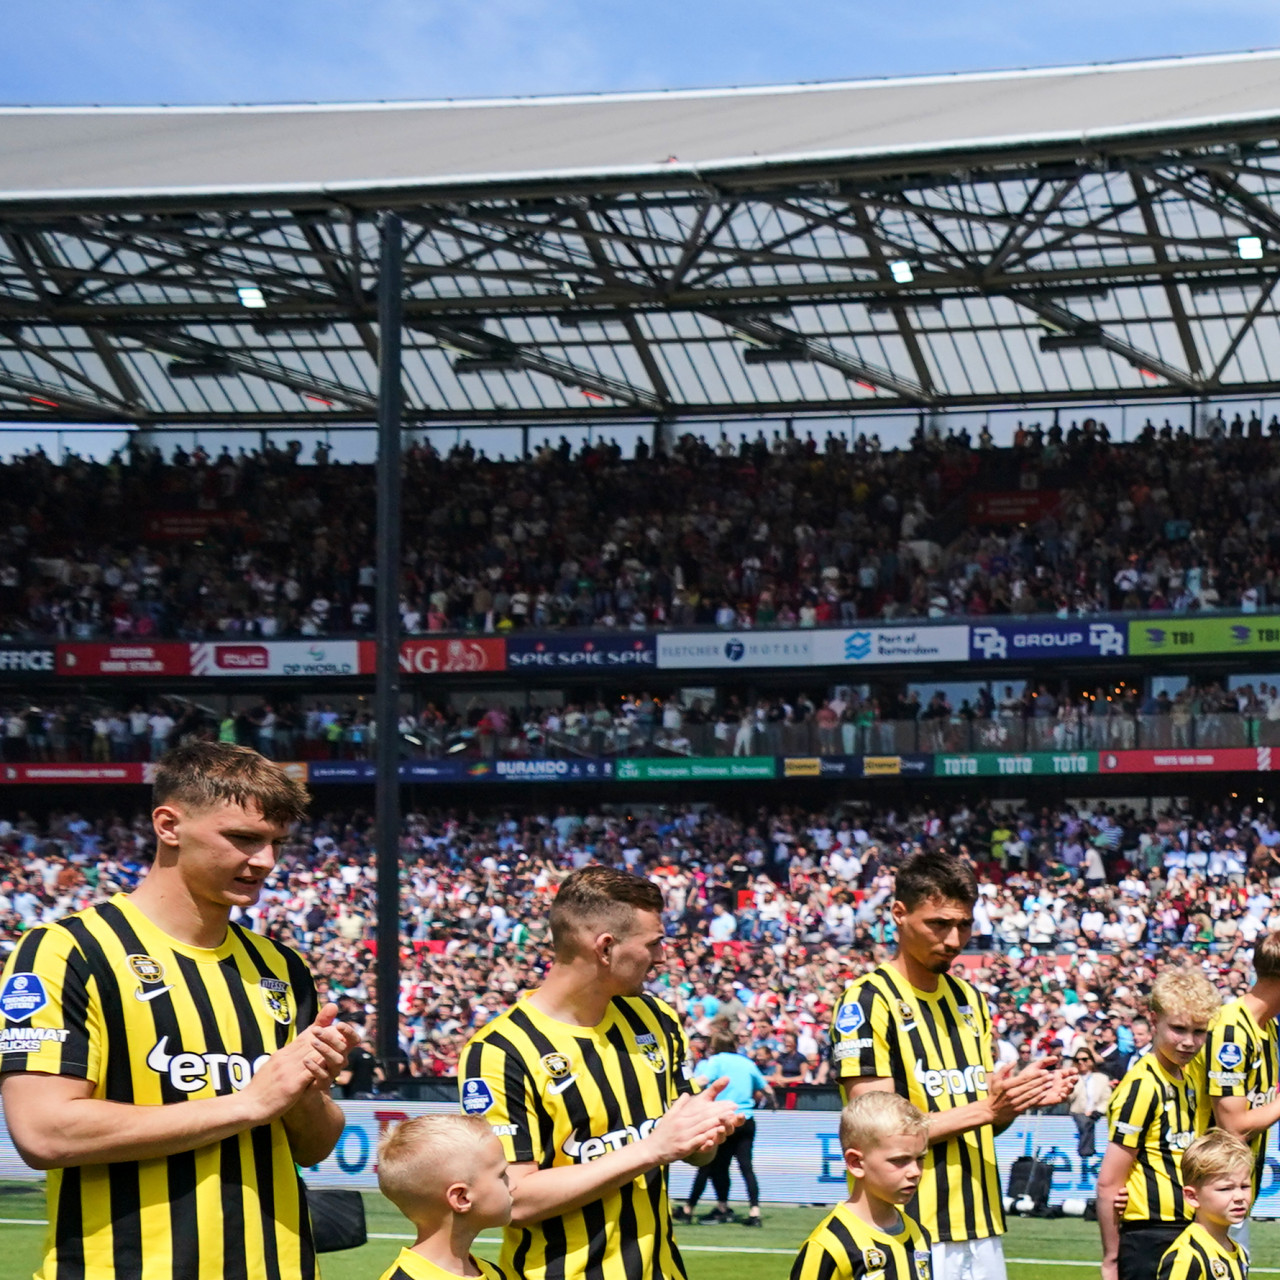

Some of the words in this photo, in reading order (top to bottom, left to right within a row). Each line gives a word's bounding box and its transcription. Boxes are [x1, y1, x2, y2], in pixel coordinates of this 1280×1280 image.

[1013, 632, 1084, 648] GROUP
[1172, 632, 1195, 645] TBI
[1257, 629, 1280, 643] TBI
[399, 647, 438, 673] NG
[496, 760, 568, 775] BURANDO
[943, 757, 978, 775] TOTO
[998, 756, 1033, 774] TOTO
[1053, 755, 1088, 773] TOTO
[0, 1027, 71, 1043] ANMAT
